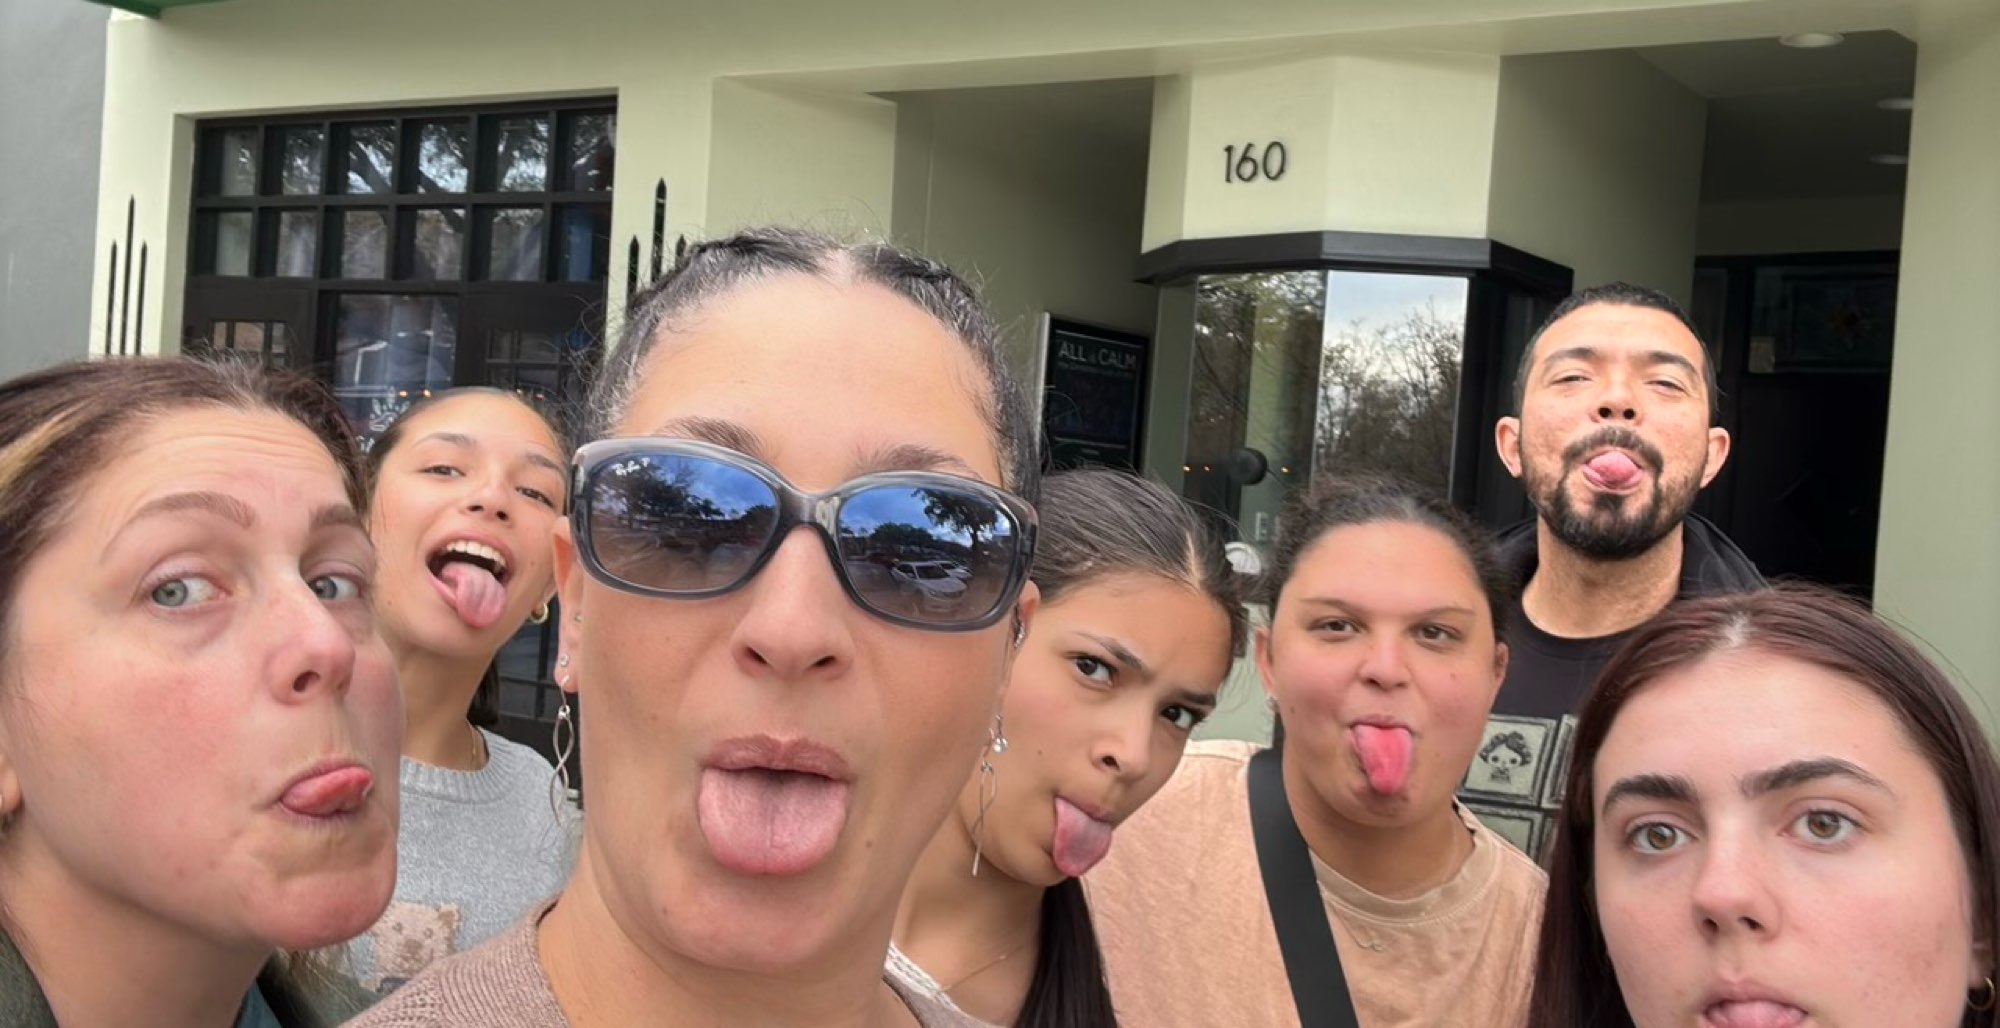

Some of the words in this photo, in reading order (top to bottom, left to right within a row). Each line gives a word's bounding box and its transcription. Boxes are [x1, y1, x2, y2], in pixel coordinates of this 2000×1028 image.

[1223, 140, 1287, 184] 160
[1059, 341, 1086, 362] ALL
[1099, 348, 1137, 371] CALM
